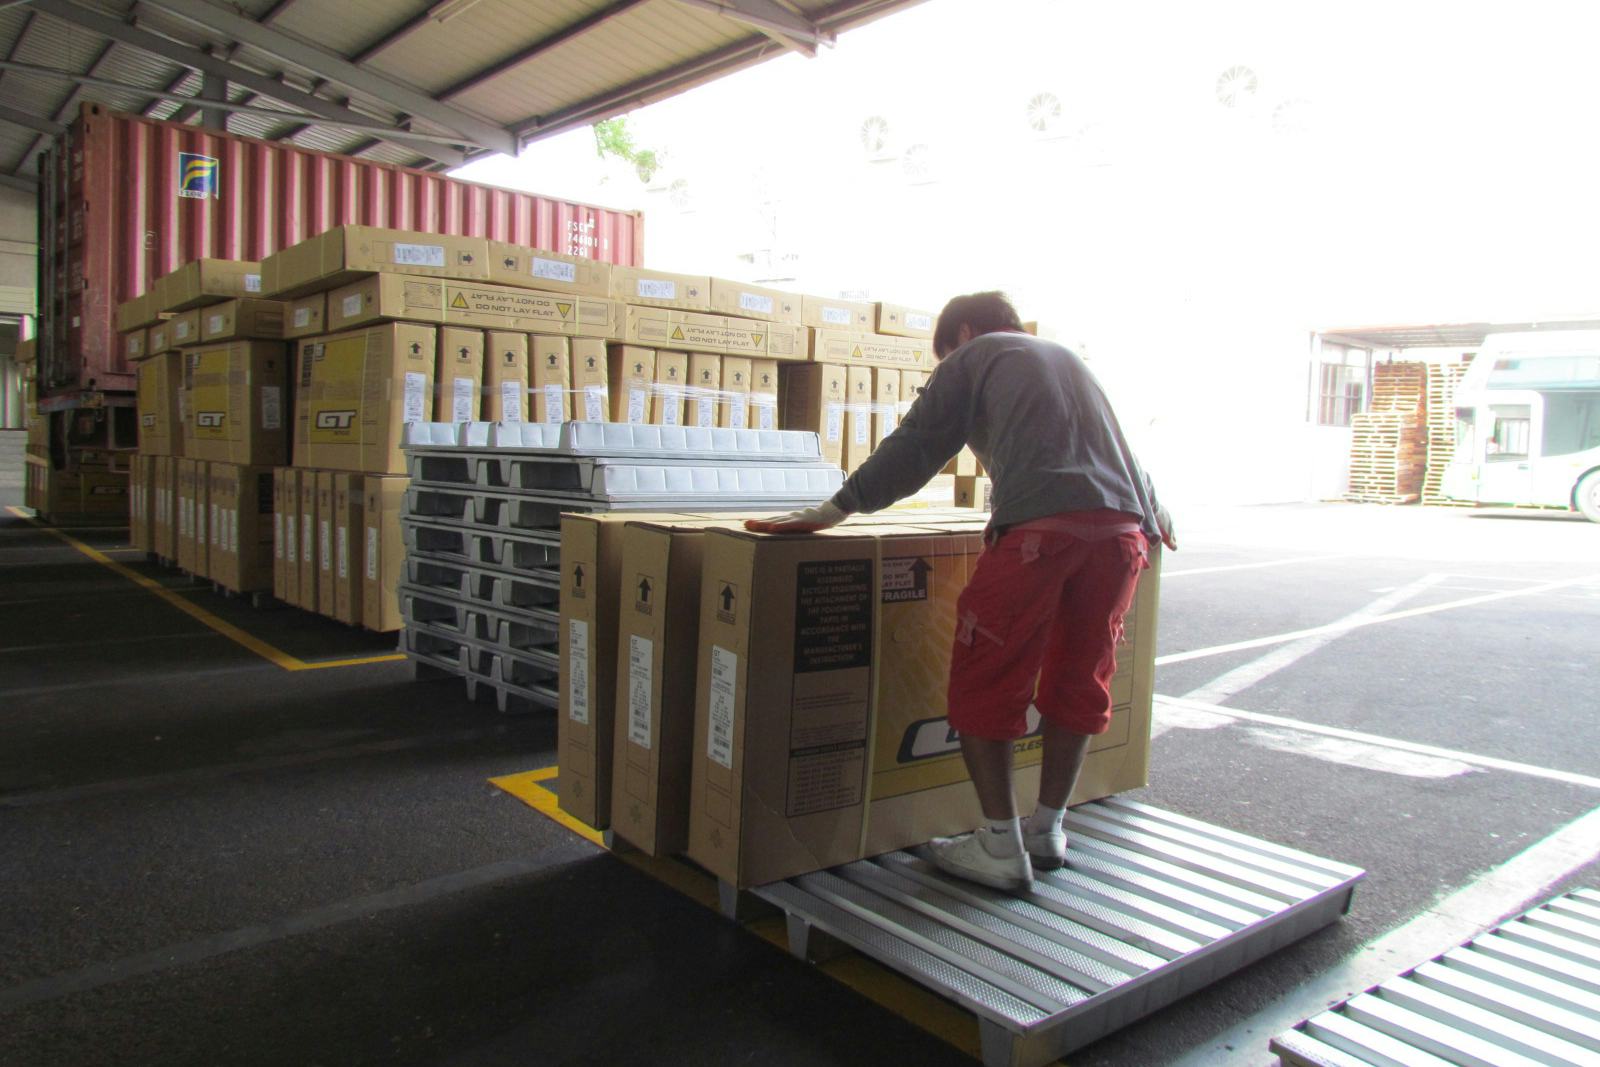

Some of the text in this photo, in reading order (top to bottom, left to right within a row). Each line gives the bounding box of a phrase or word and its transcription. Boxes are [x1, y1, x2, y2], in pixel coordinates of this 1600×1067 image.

[532, 309, 555, 317] FLAT
[197, 411, 225, 427] GT
[316, 410, 357, 428] GT
